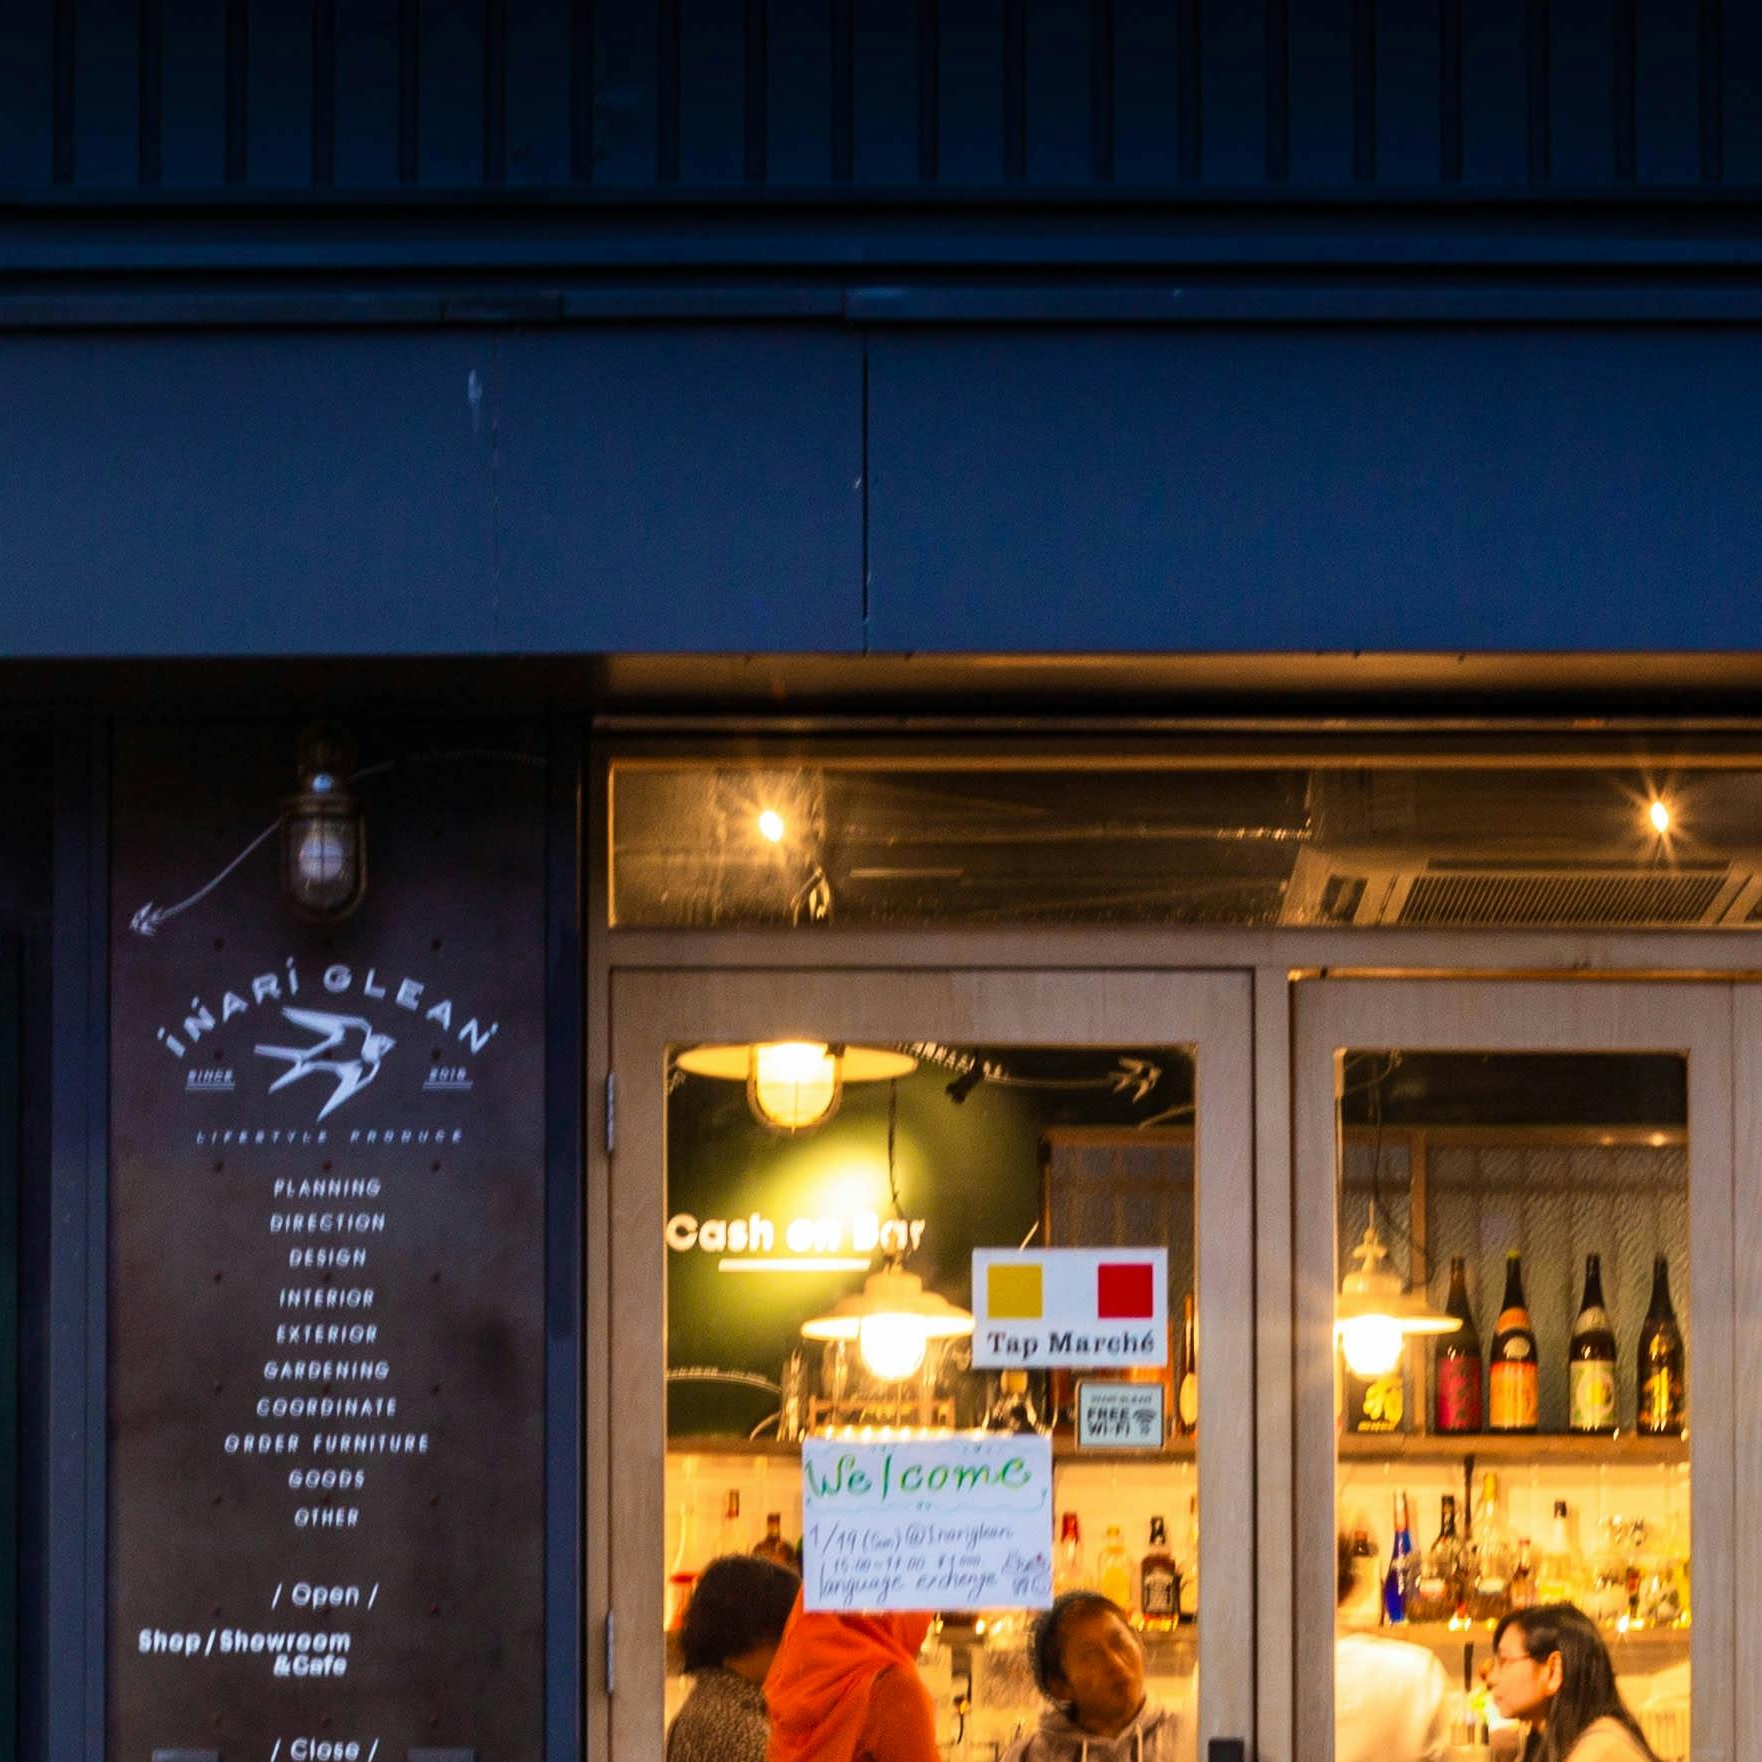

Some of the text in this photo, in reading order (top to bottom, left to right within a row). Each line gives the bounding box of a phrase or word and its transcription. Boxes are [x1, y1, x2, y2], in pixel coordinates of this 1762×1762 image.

[323, 964, 499, 1055] GLEAN
[195, 1129, 328, 1145] LIFESTYLE
[274, 1178, 381, 1198] PLANNING
[270, 1213, 385, 1234] DIRECTION
[666, 1211, 775, 1252] Cash
[289, 1247, 366, 1268] DESIGN
[279, 1288, 375, 1308] INTERIOR
[276, 1325, 377, 1344] EXTERIOR
[986, 1328, 1155, 1360] Tap Marché
[263, 1360, 390, 1381] GARDENING
[256, 1397, 397, 1418] COORDINATE
[1087, 1406, 1130, 1421] FREE
[225, 1434, 429, 1454] ORDER FURNITURE
[288, 1469, 365, 1489] GOODS
[804, 1453, 1032, 1500] Welcome
[294, 1508, 359, 1528] OTHER
[819, 1561, 905, 1604] language
[291, 1582, 360, 1609] Open
[290, 1738, 360, 1762] Close
